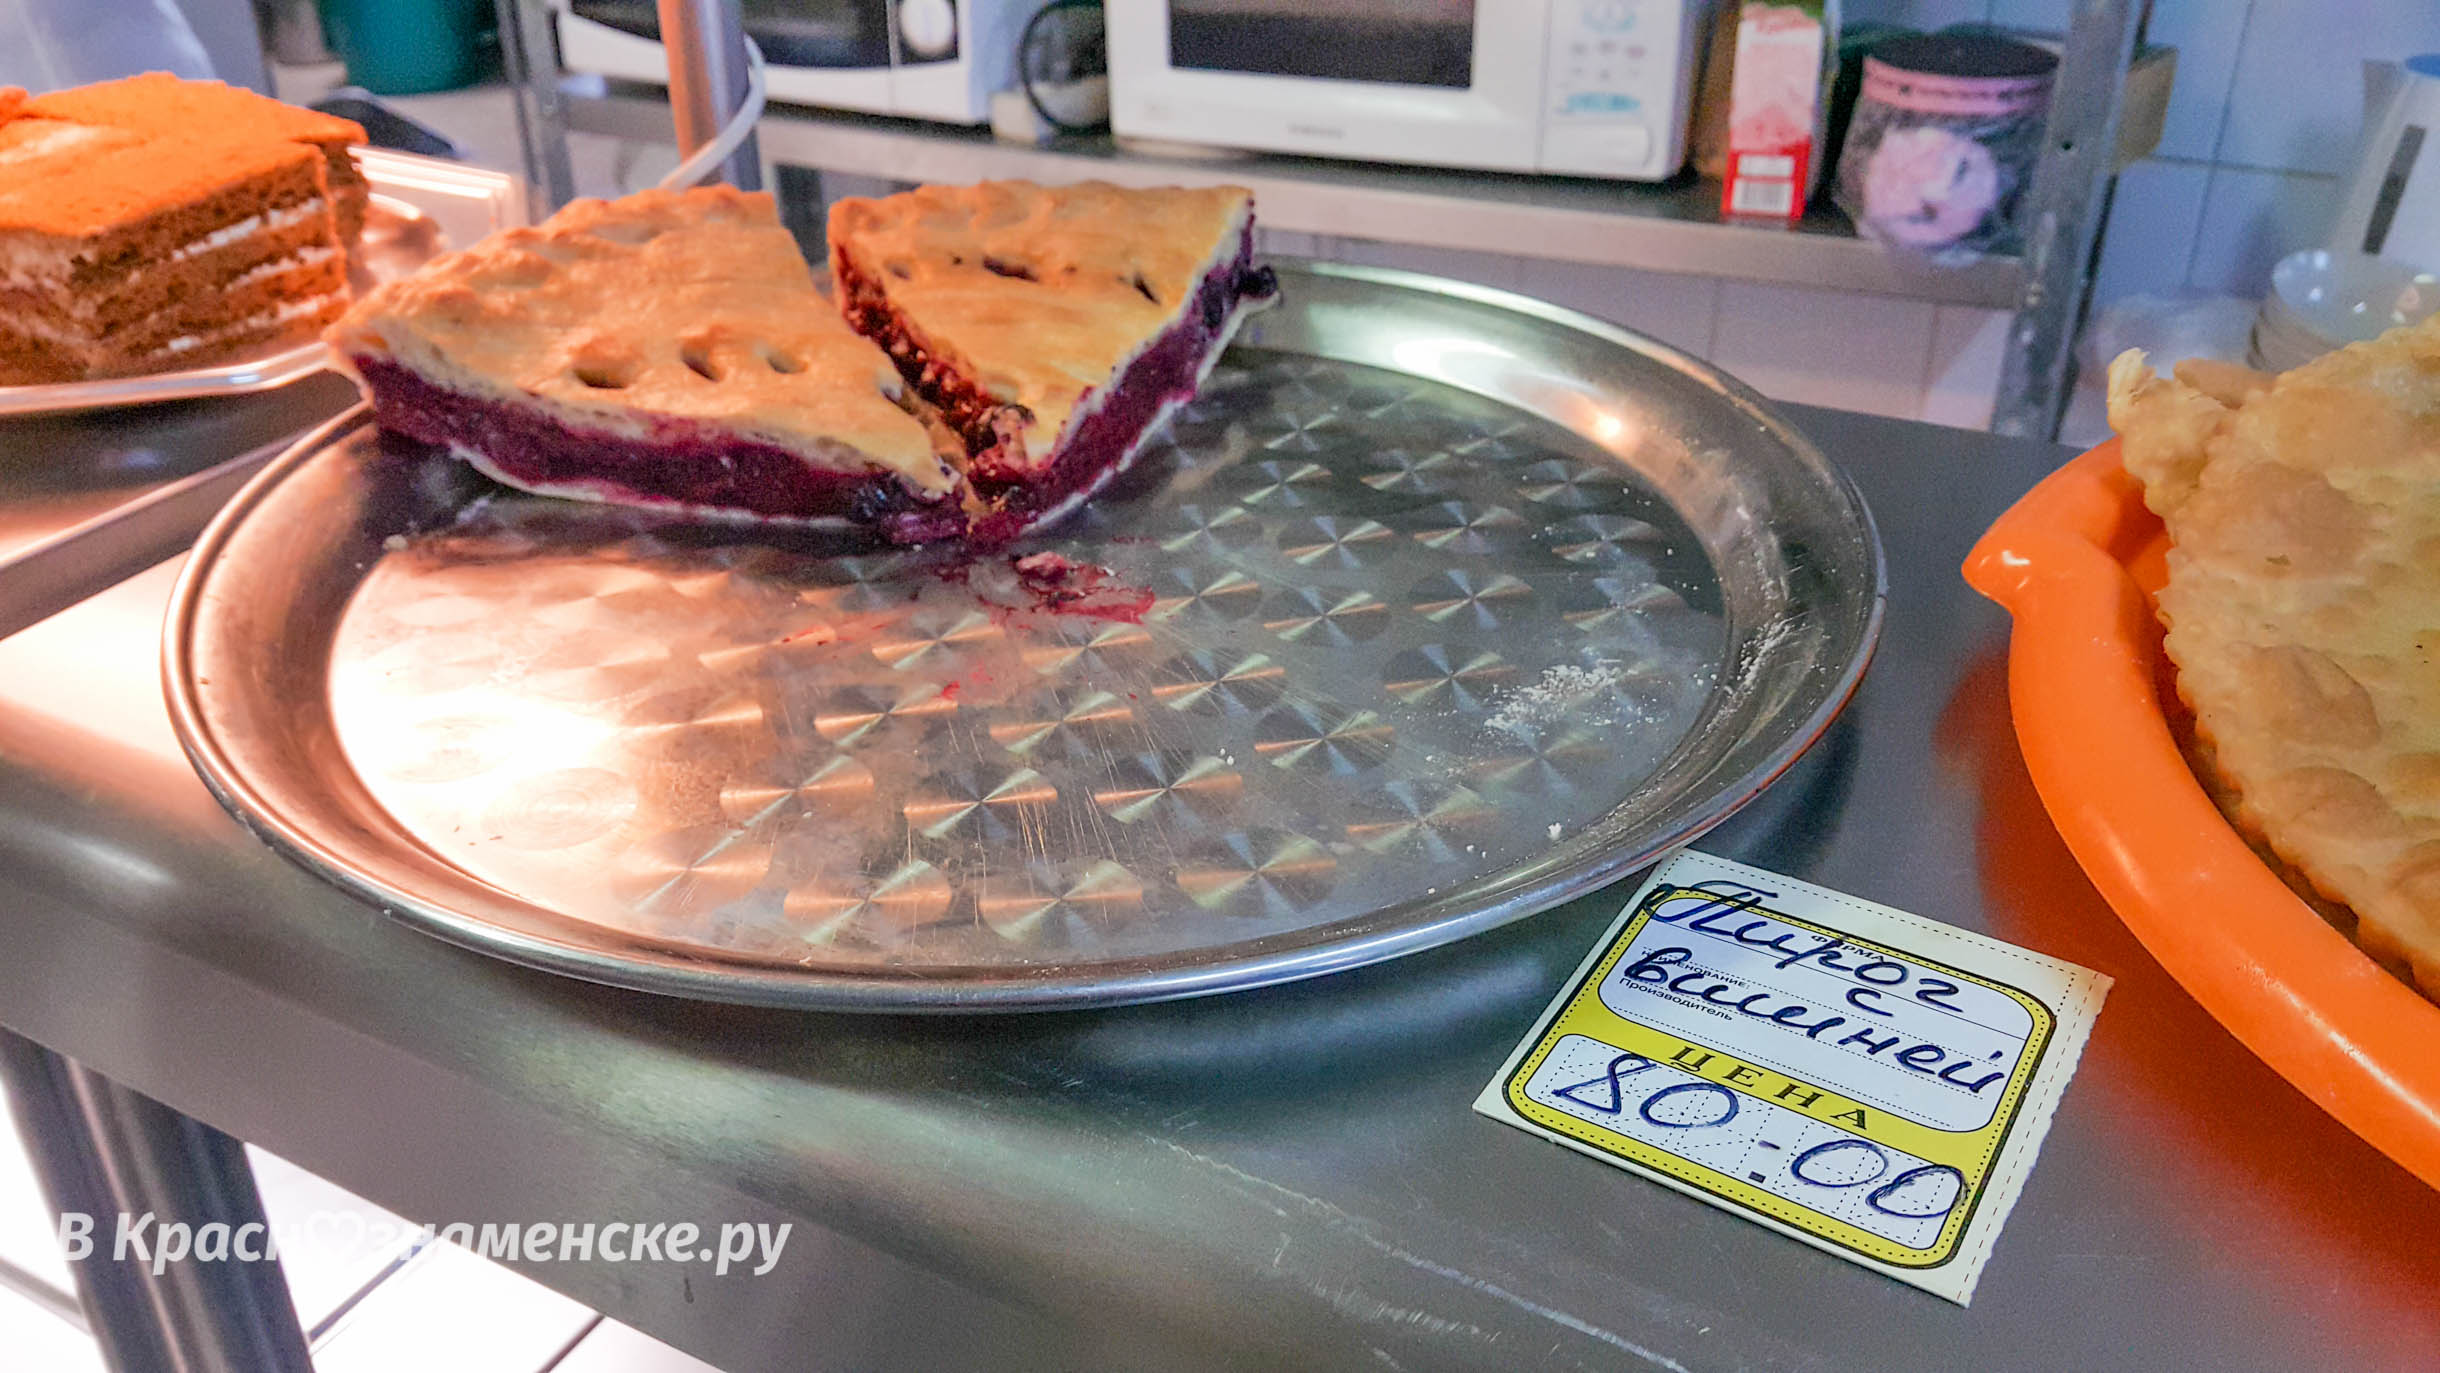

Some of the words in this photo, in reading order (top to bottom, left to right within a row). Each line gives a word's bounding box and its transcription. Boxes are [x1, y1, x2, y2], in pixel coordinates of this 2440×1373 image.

[1811, 935, 1884, 962] ФРМА
[1619, 977, 1734, 1021] Производитель
[1668, 1046, 1868, 1130] ЦЕНА
